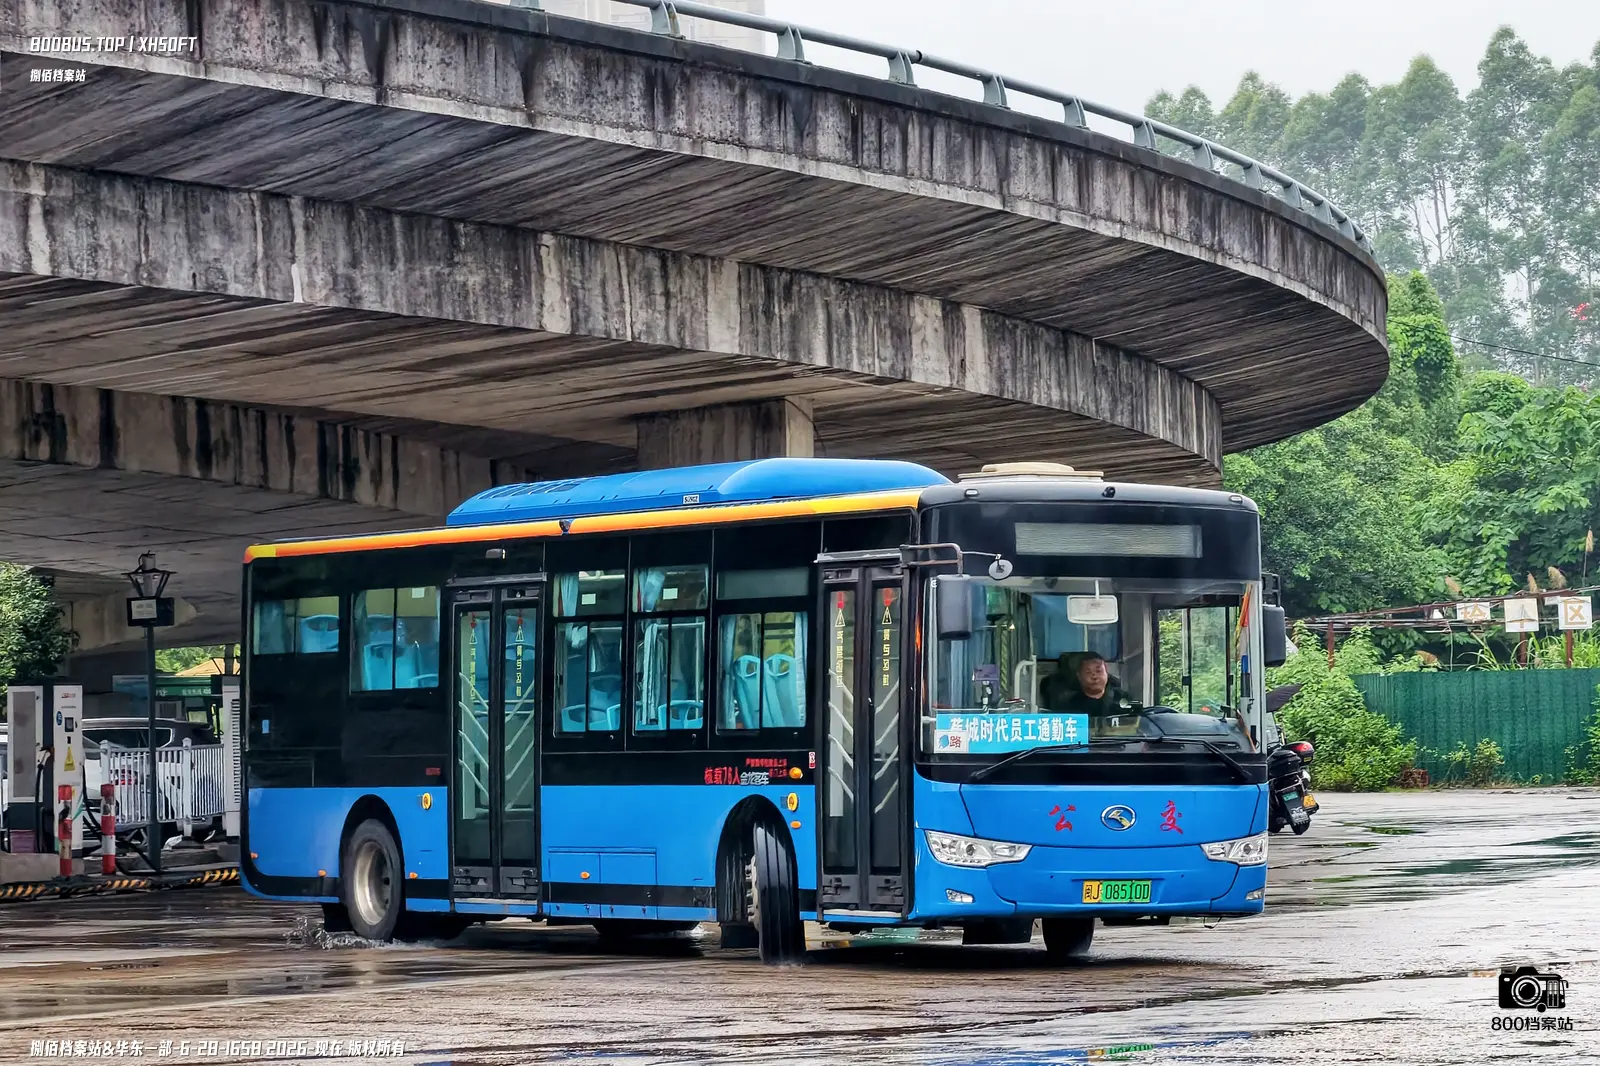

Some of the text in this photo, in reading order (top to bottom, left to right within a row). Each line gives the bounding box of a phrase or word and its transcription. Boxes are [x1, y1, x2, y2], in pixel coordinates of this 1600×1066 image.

[1048, 800, 1183, 835] 公 交
[1105, 884, 1150, 900] 08510D
